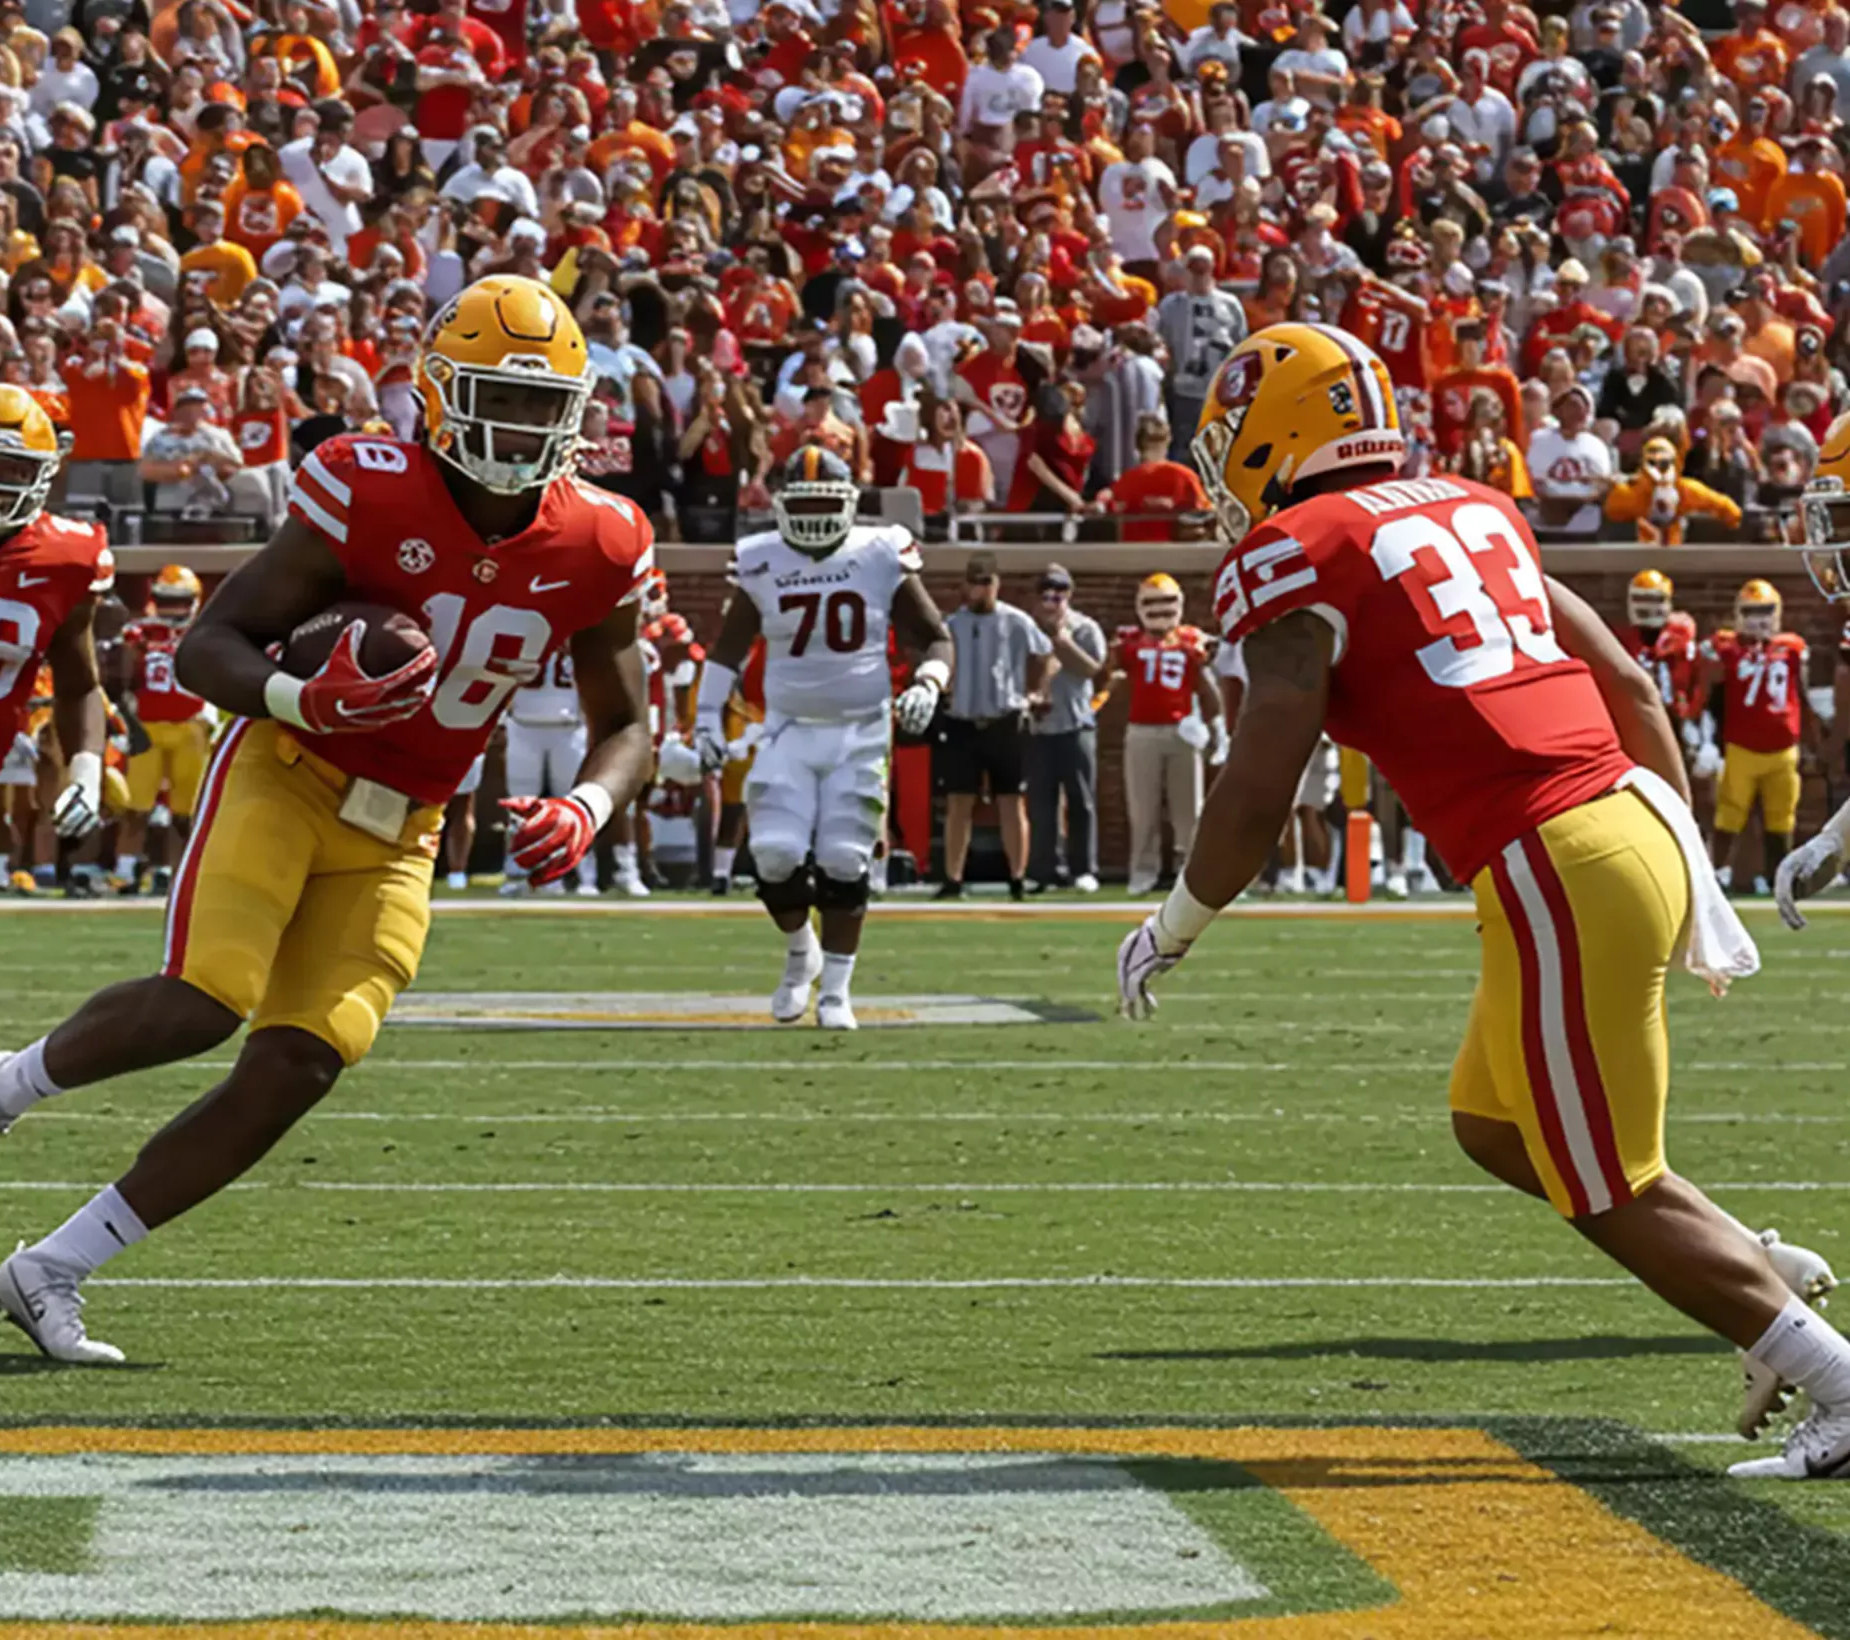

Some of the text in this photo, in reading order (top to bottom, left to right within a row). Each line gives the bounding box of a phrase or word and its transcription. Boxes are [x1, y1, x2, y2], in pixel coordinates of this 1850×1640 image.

[421, 592, 552, 729] 18
[778, 590, 867, 658] 70
[1370, 503, 1572, 688] 33
